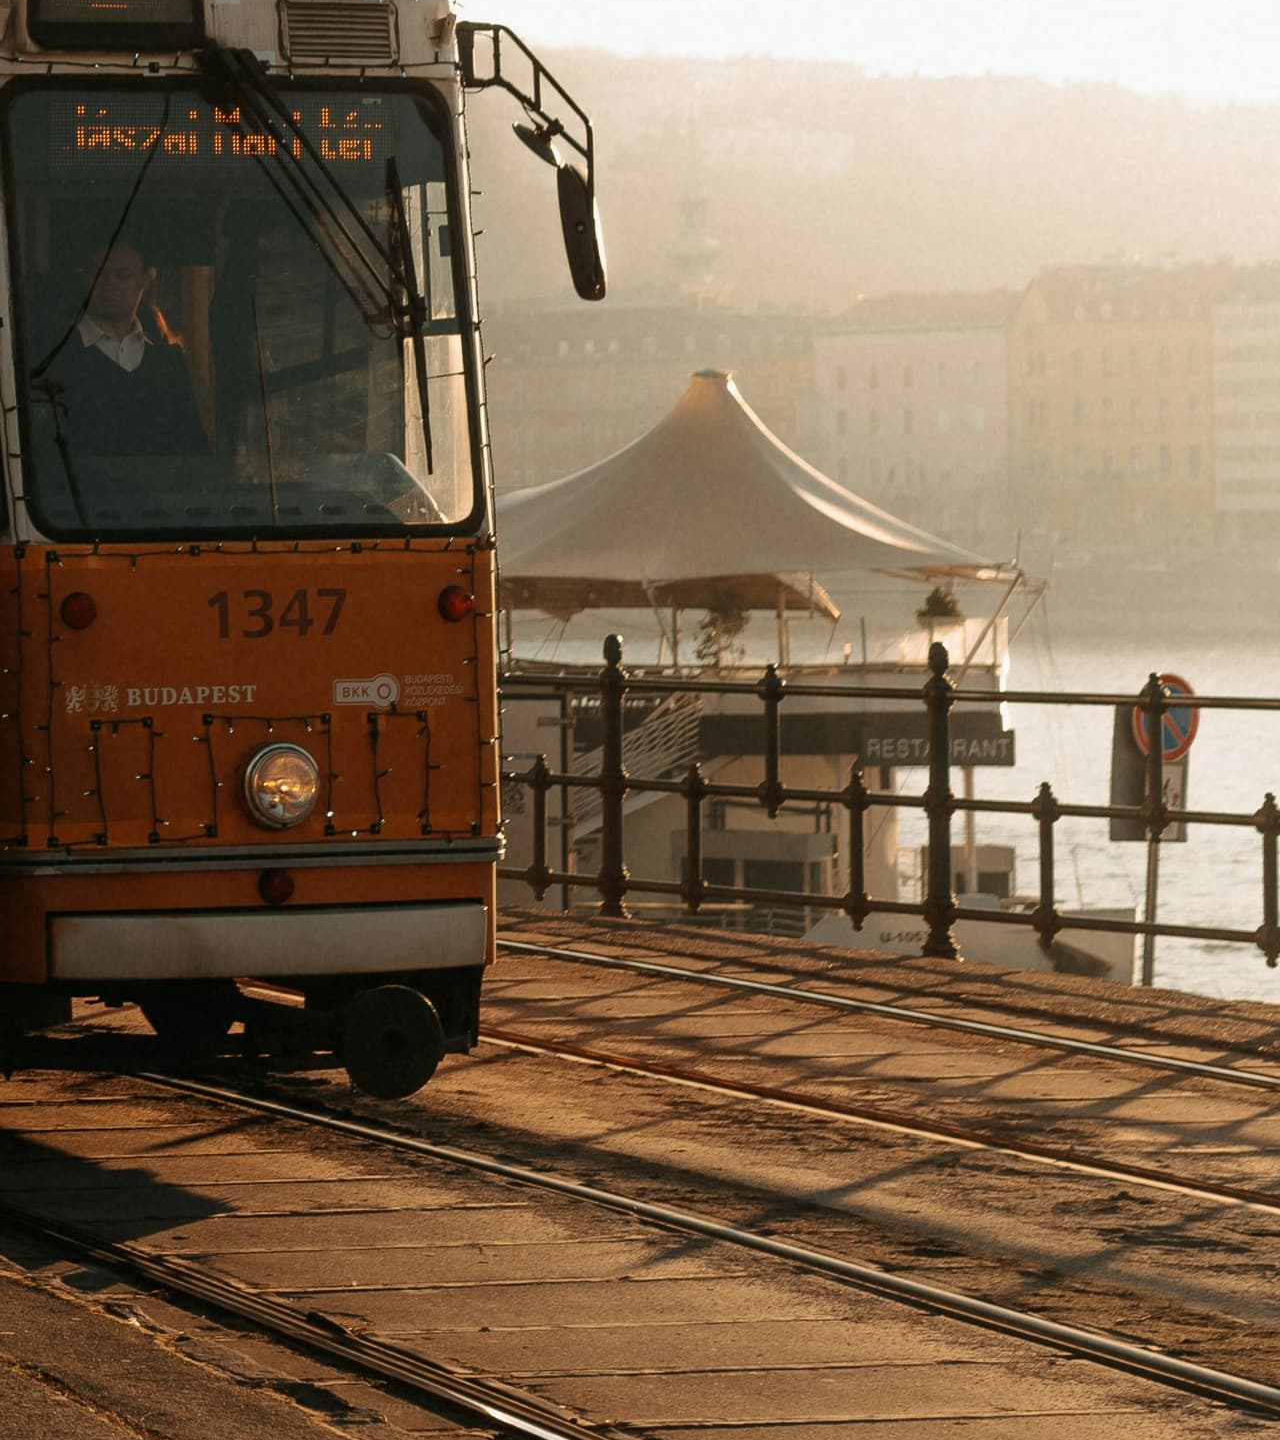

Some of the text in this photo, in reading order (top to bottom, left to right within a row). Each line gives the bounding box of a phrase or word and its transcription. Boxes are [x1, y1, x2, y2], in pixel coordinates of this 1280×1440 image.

[207, 587, 347, 639] 1347
[404, 673, 453, 684] BUDAPESTI
[126, 684, 257, 706] BUDAPEST
[342, 686, 370, 698] BKK
[404, 696, 447, 707] KÖZPONT
[866, 737, 1011, 759] RESTRANT
